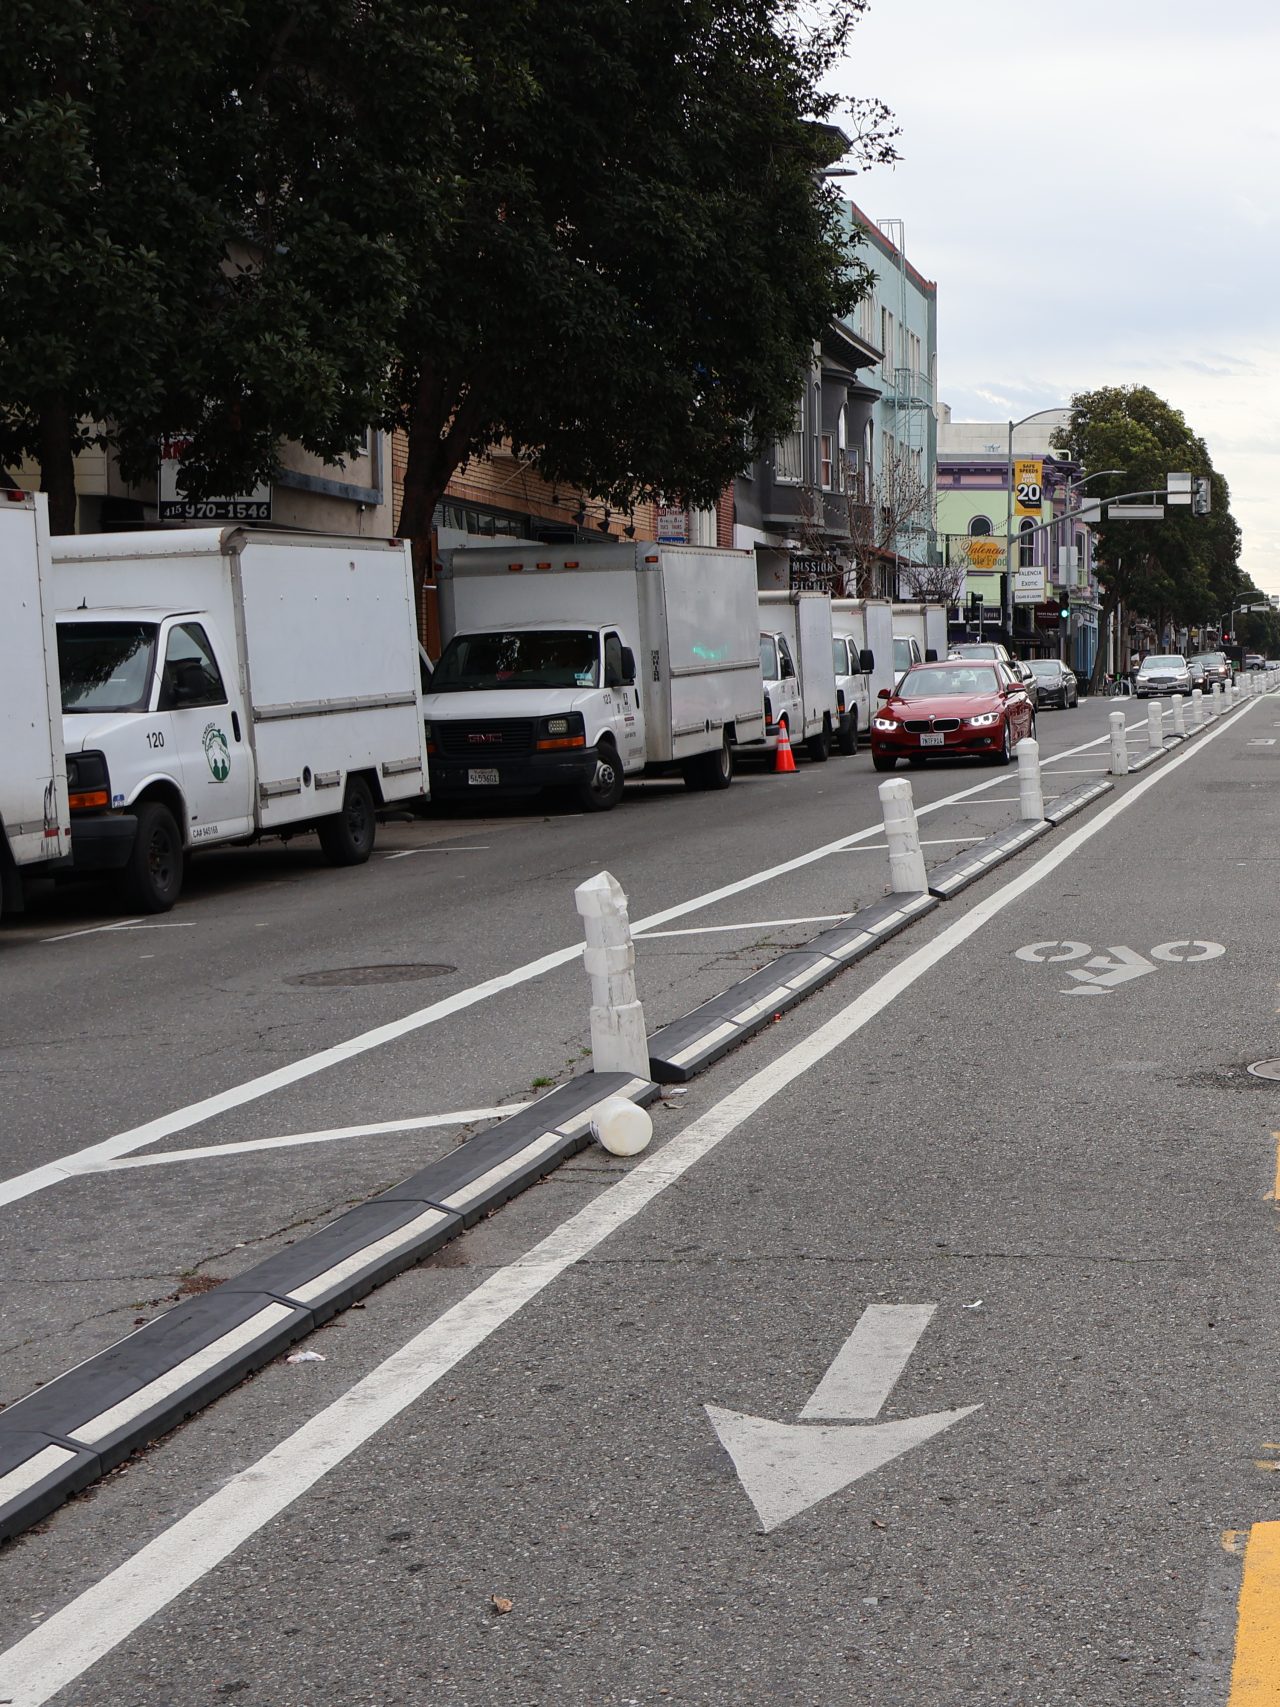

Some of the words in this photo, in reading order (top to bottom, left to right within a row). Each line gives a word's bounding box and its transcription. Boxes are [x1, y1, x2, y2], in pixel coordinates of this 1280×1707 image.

[1017, 484, 1040, 500] 20
[164, 505, 182, 516] 415
[185, 504, 268, 518] 970-1546
[960, 540, 1006, 556] Valencia
[792, 561, 833, 572] MISSION
[146, 731, 165, 749] 120
[468, 732, 503, 744] GMC
